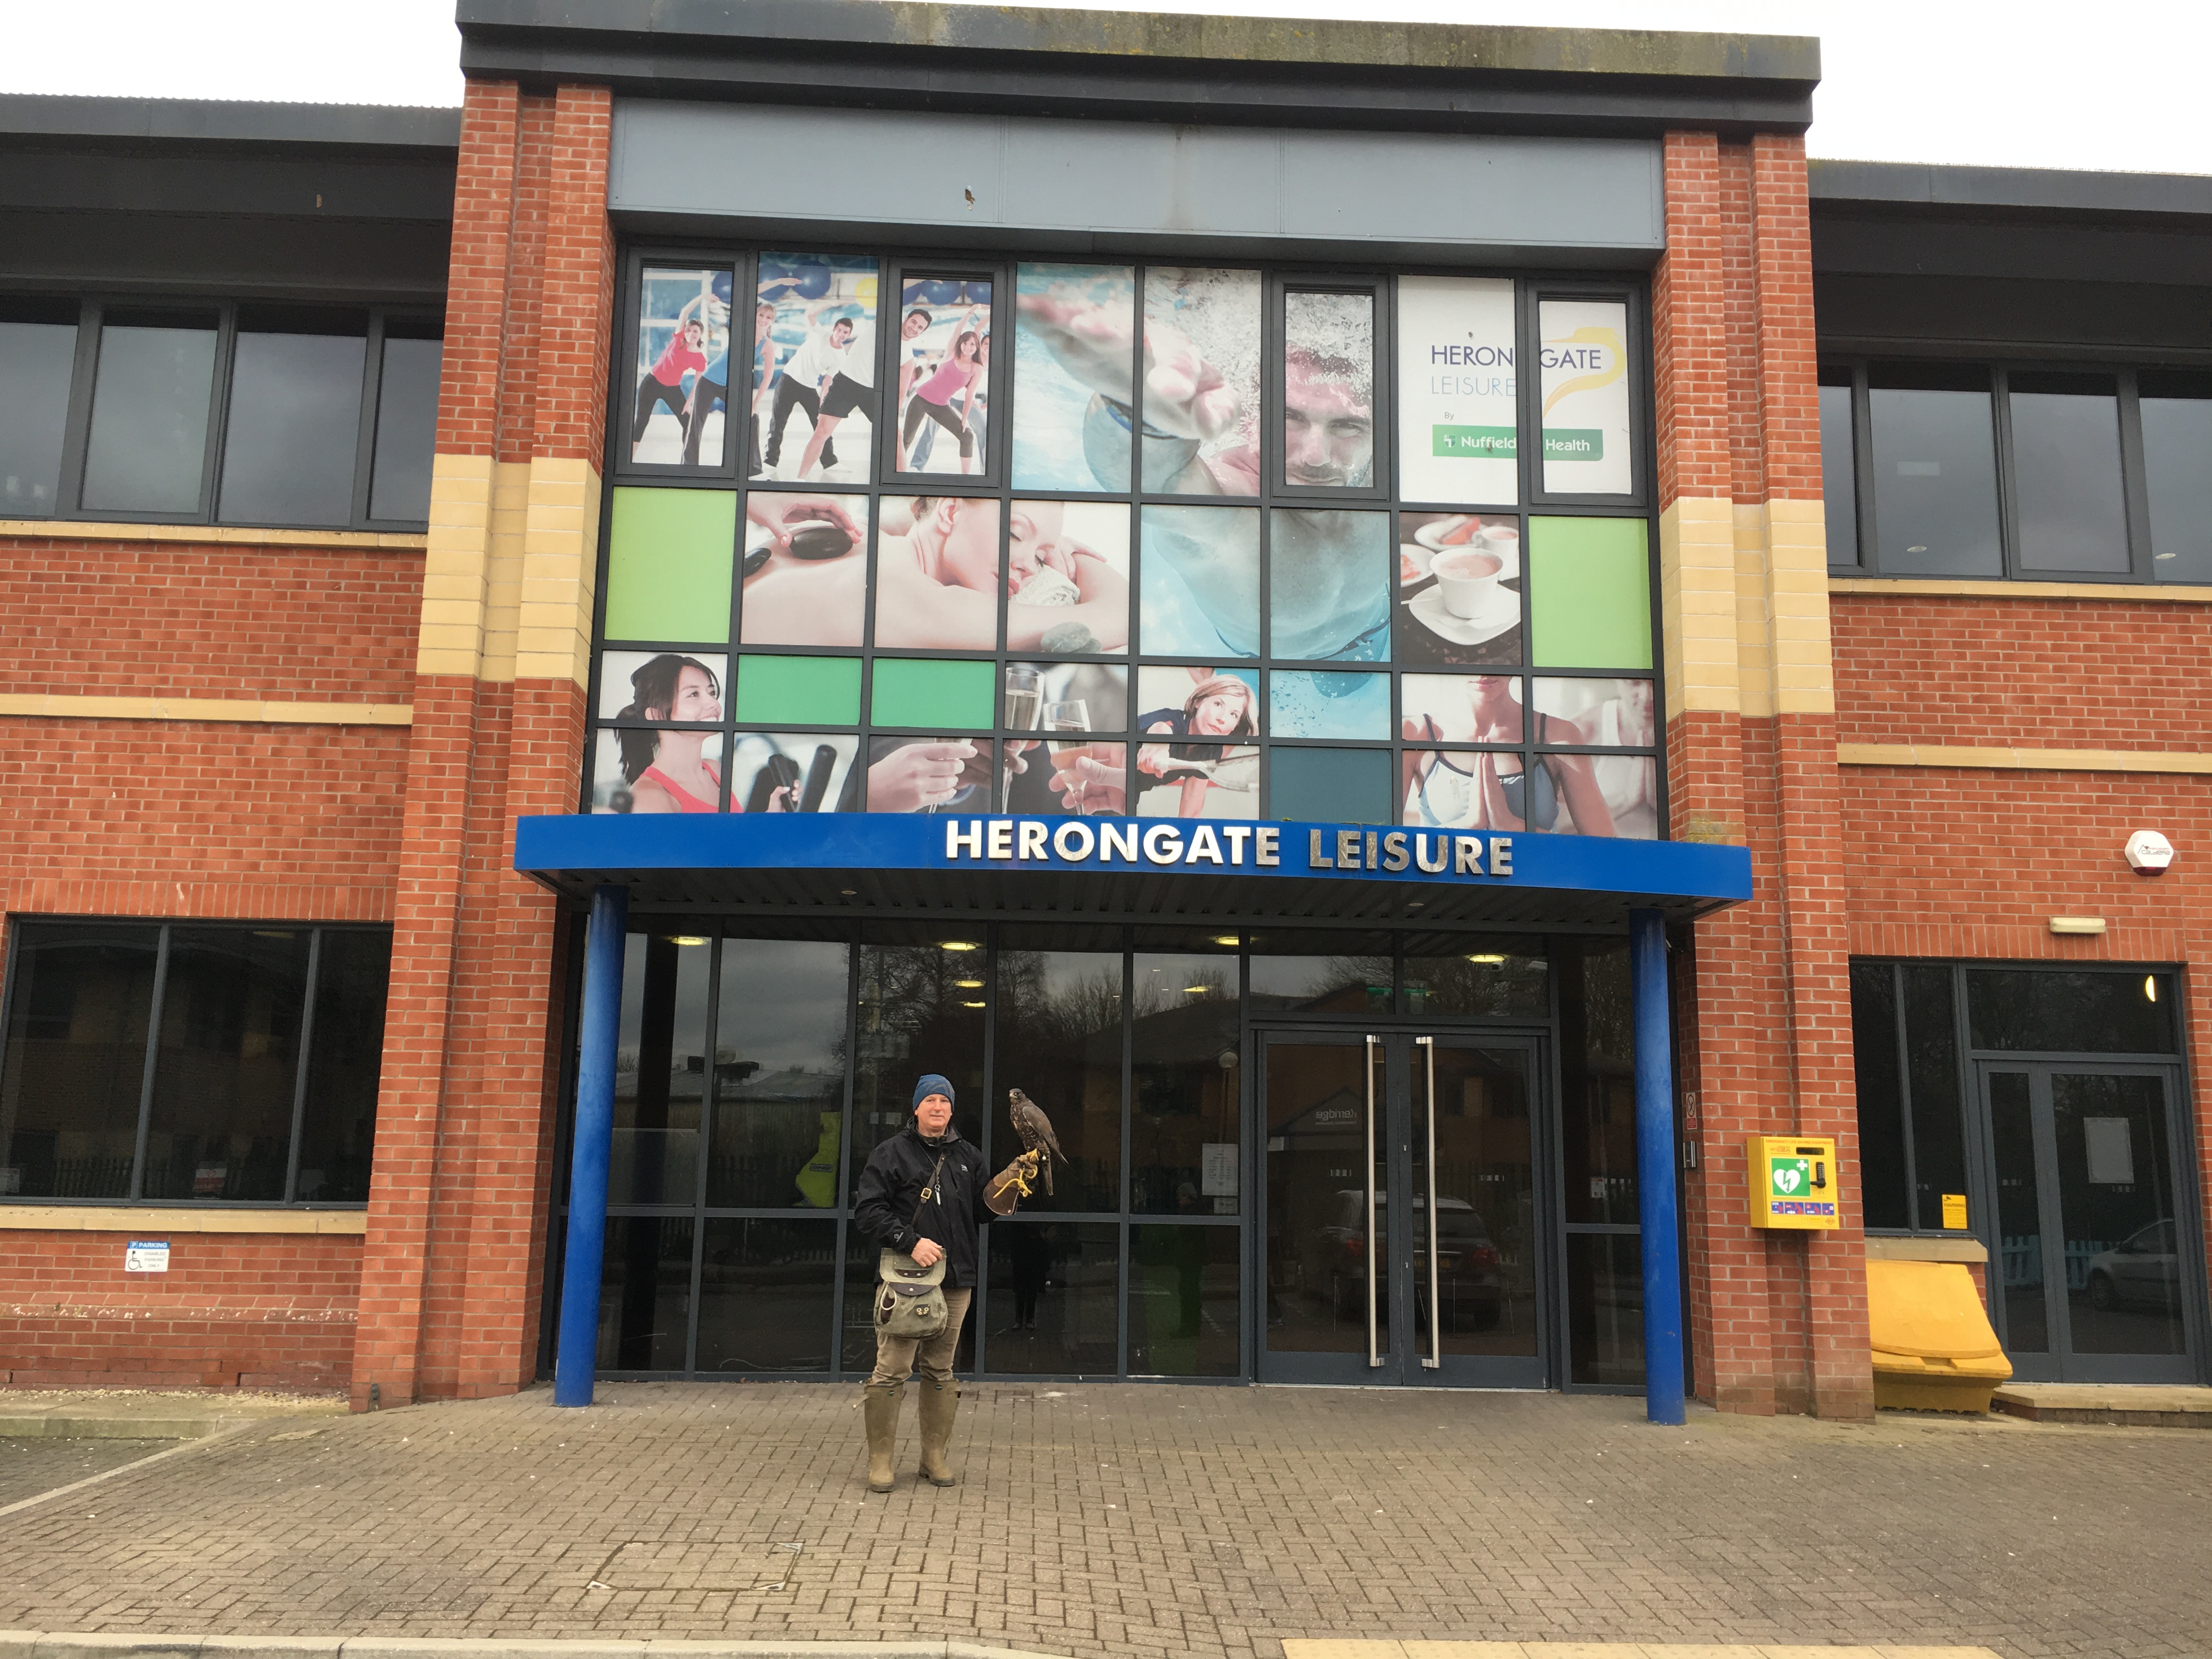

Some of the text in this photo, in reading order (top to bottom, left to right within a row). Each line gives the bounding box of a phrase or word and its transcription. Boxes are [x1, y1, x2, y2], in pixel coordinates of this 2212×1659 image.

[1431, 376, 1516, 397] LEISURE
[1444, 412, 1454, 420] By
[1461, 435, 1590, 452] Nuffield Health
[946, 820, 1280, 865] HERONGATE
[1309, 829, 1513, 875] LEISURE
